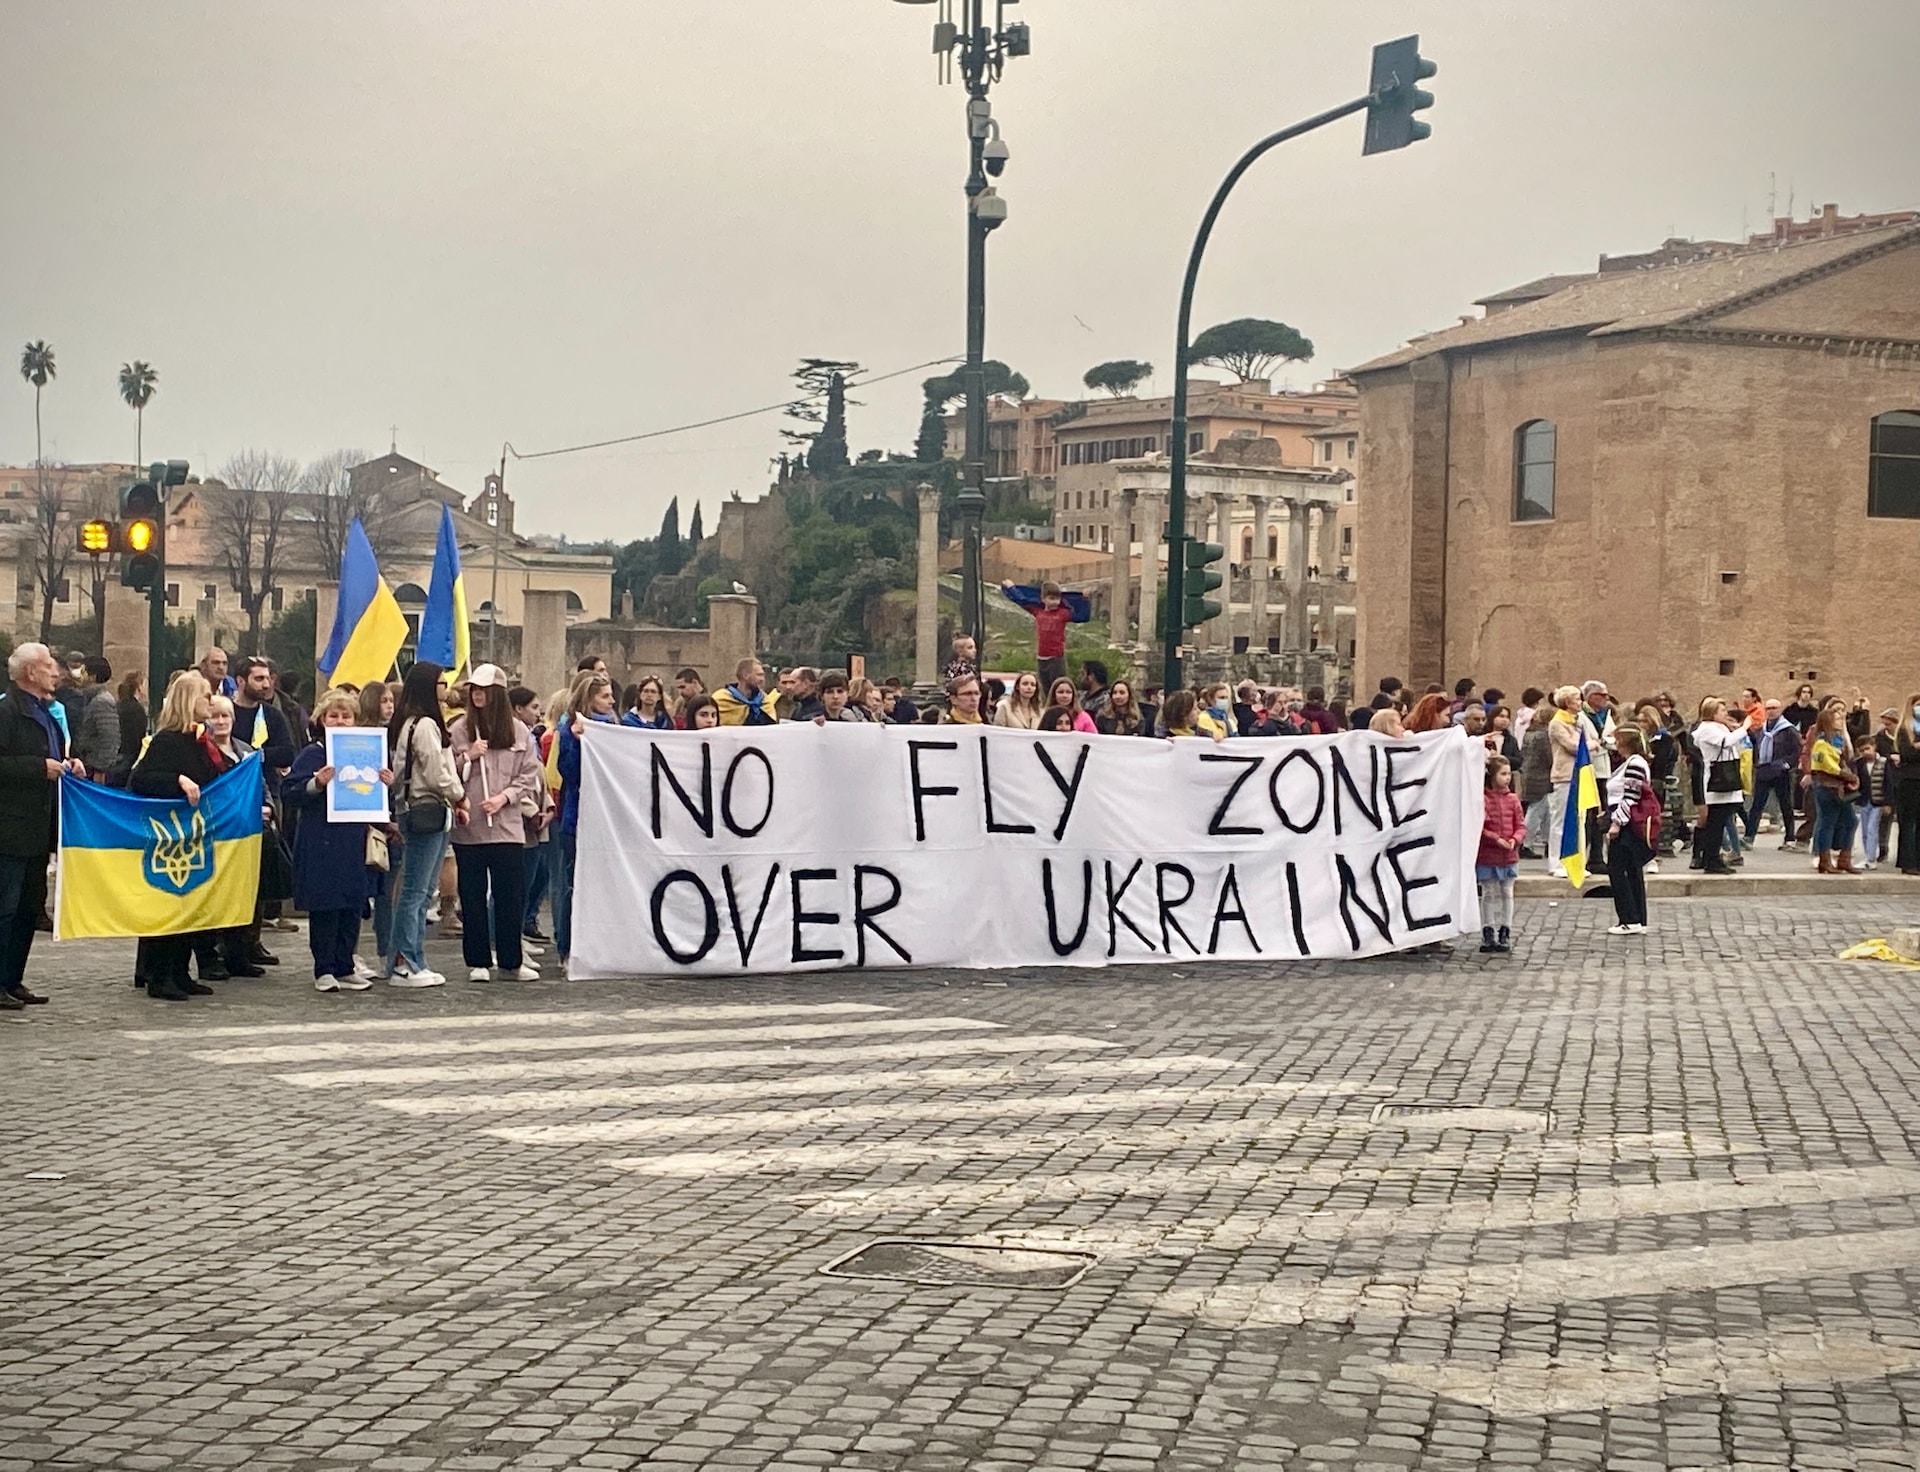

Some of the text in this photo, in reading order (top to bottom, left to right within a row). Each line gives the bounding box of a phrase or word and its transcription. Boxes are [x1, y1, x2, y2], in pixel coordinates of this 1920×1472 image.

[651, 736, 1427, 841] NO FLY ZONE
[650, 836, 1452, 967] OVER UKRAINE
